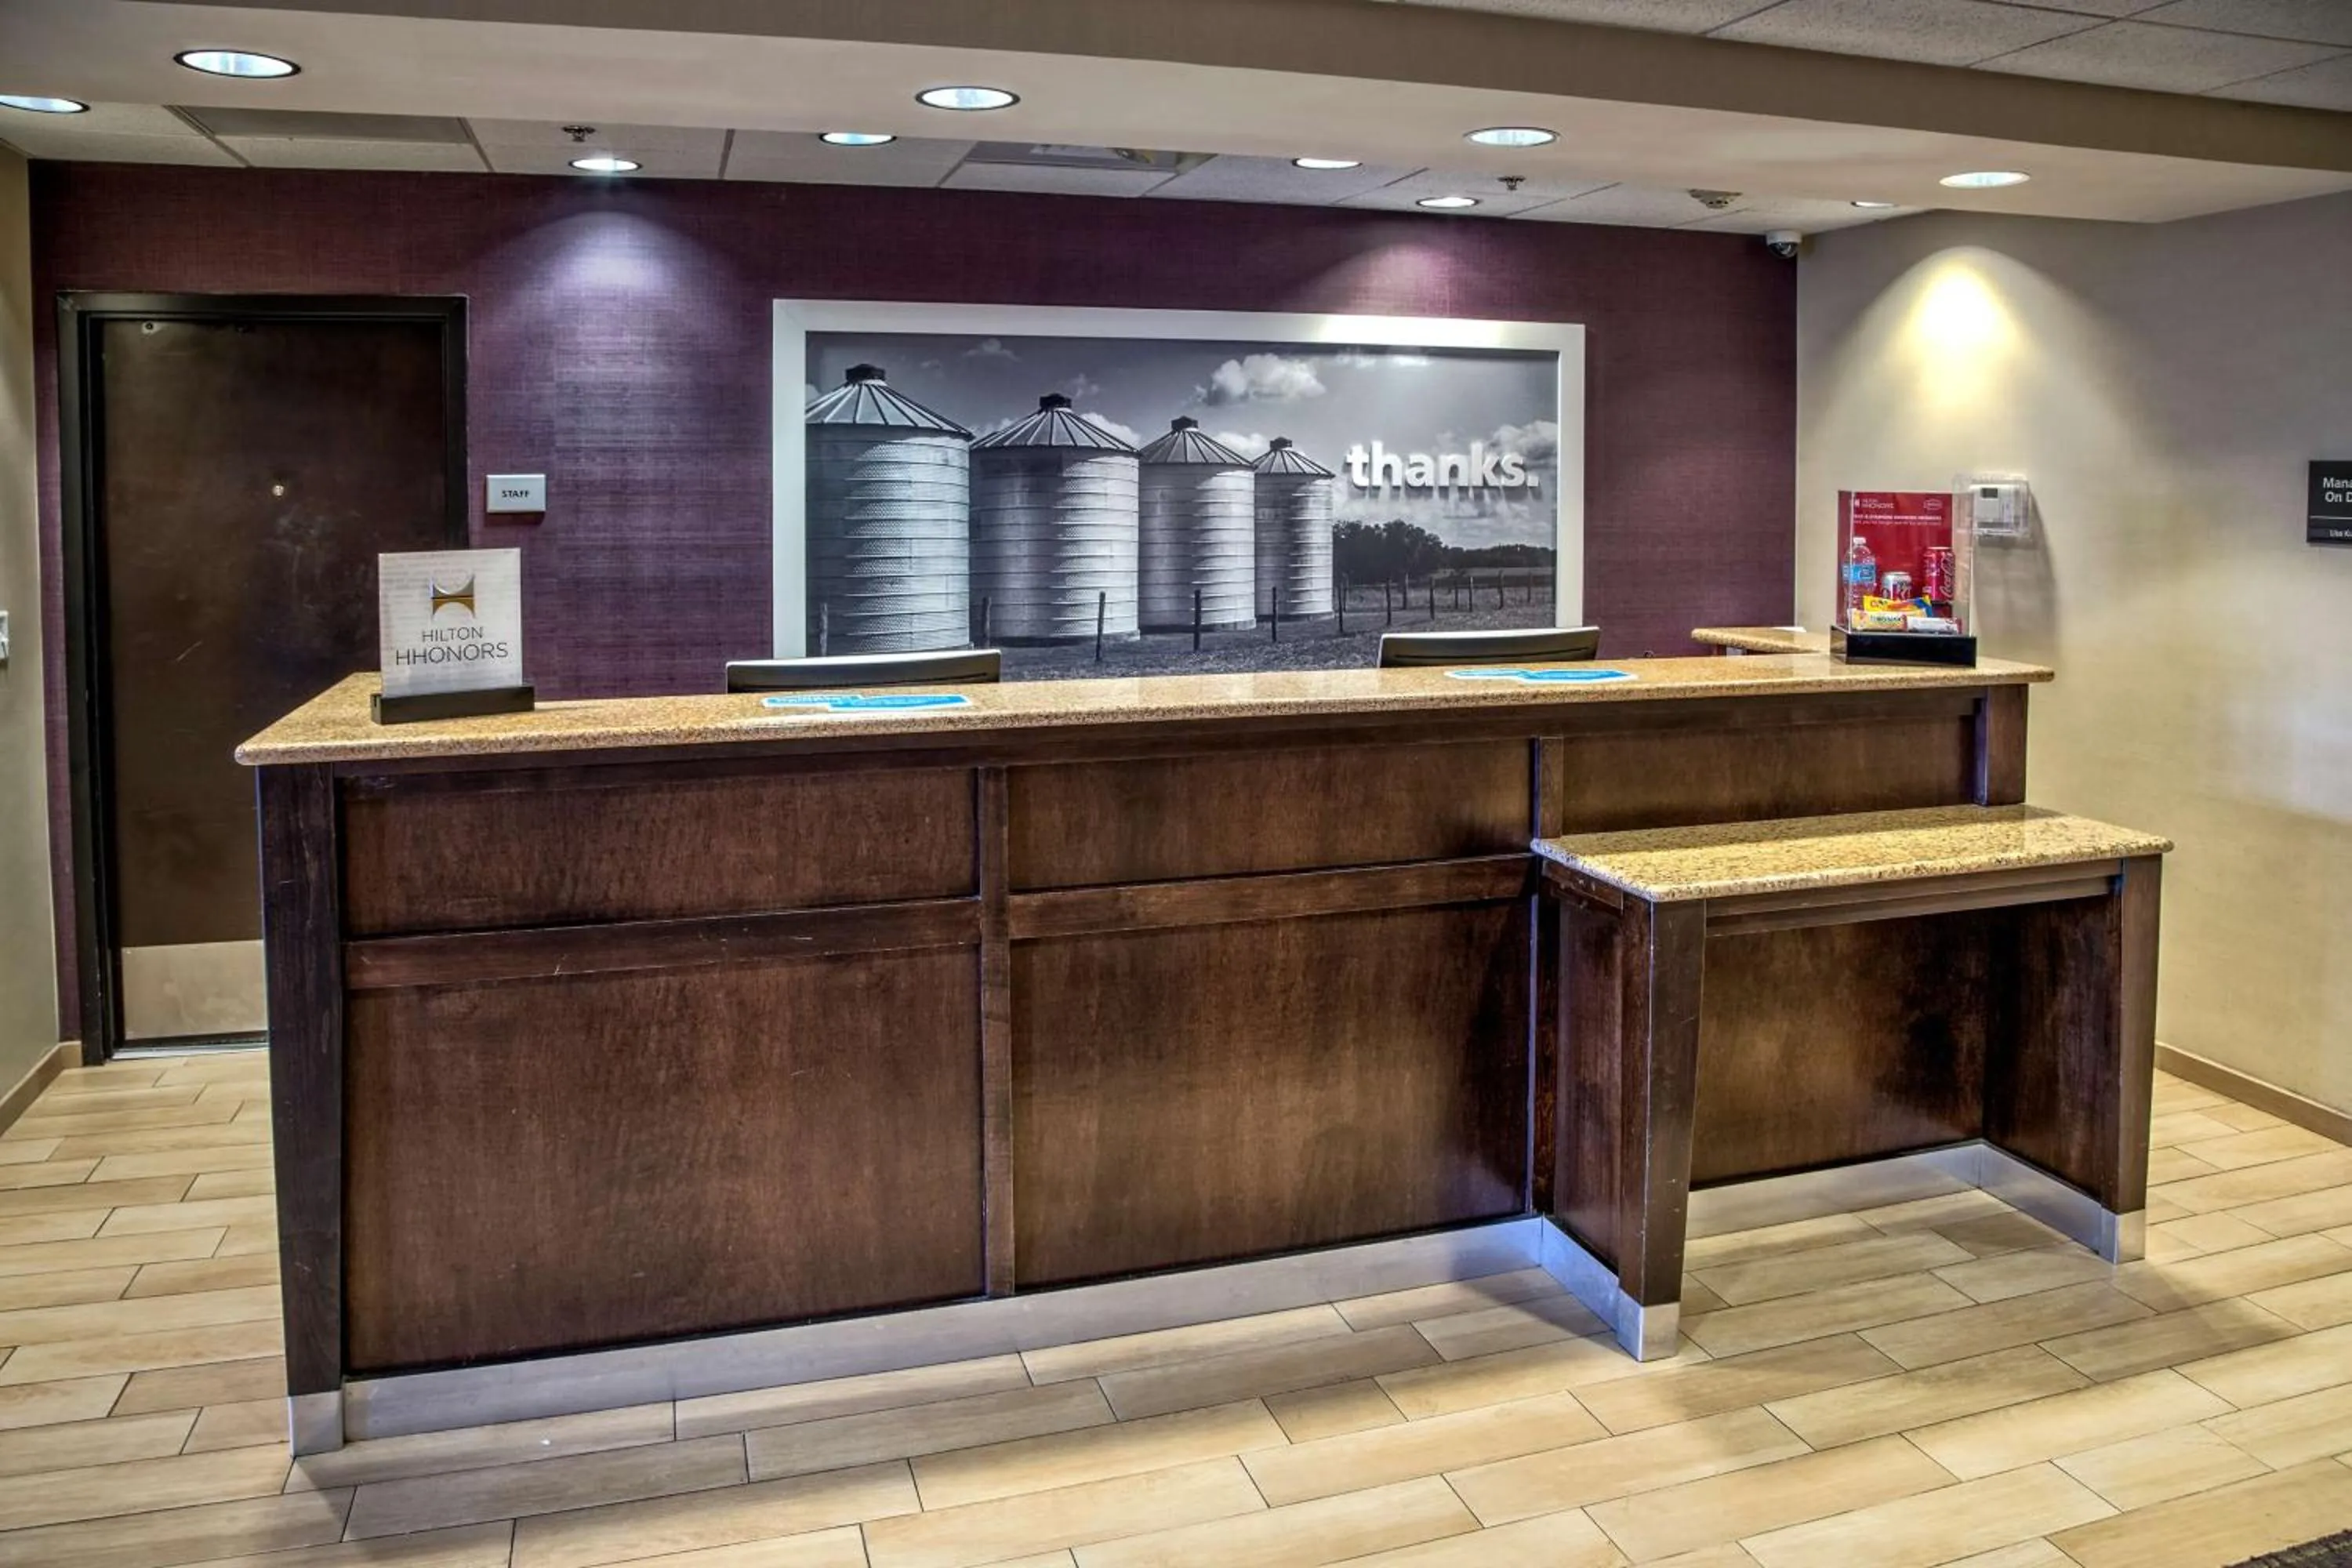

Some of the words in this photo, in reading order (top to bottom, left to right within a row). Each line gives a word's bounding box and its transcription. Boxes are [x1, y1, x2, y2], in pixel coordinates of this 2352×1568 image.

[1346, 440, 1539, 487] thanks.
[2325, 492, 2342, 503] On
[422, 626, 483, 642] HILTON
[396, 642, 508, 665] HHONORS
